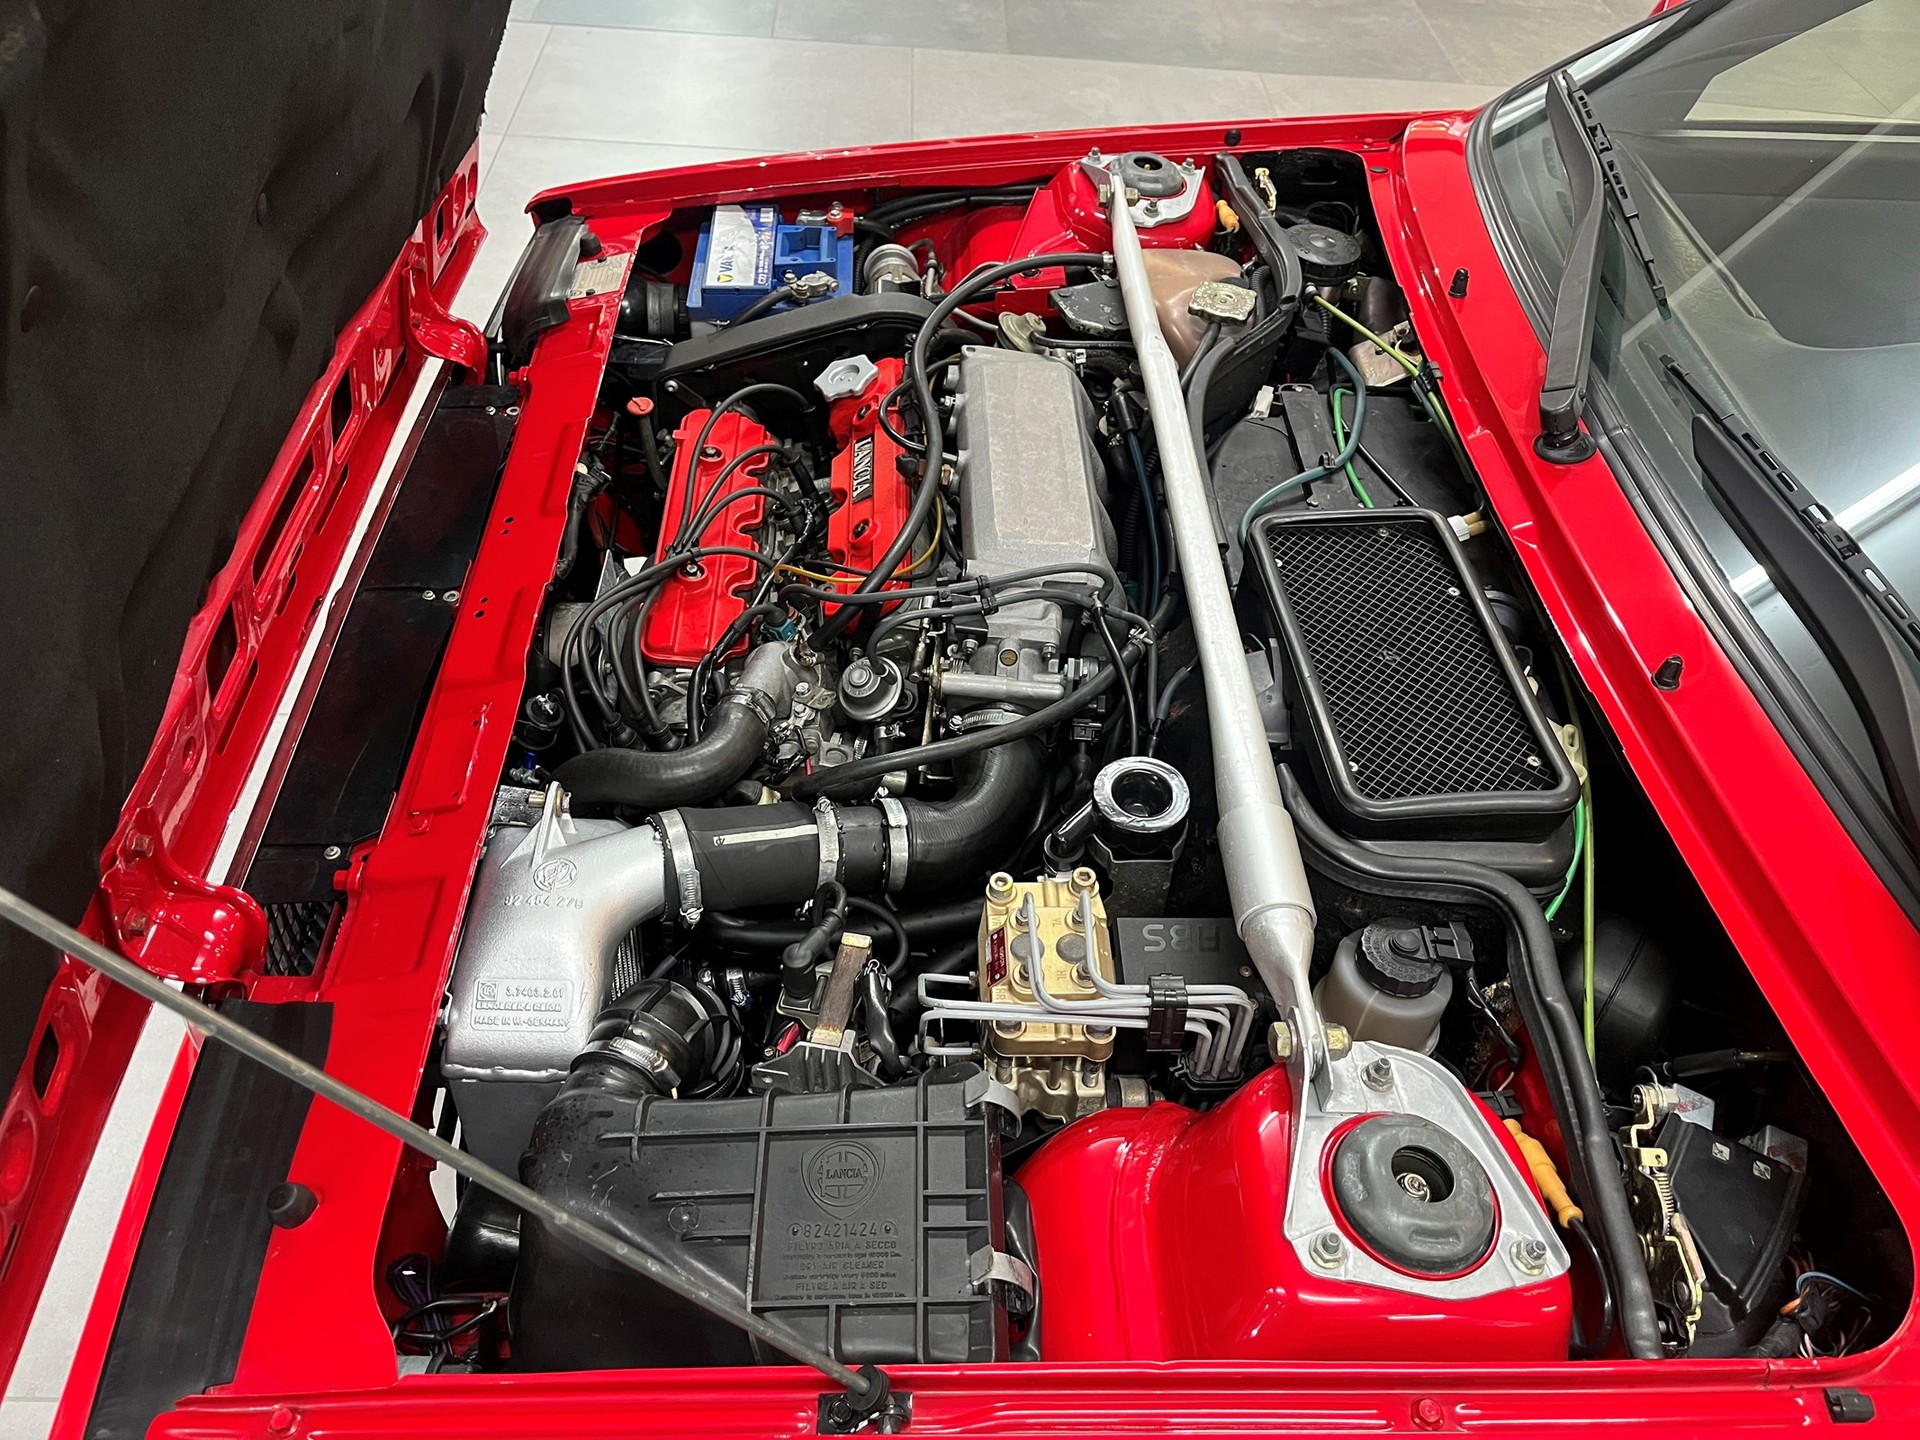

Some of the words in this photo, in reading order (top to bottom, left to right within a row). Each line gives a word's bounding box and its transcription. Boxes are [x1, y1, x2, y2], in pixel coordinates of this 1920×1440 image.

[853, 437, 872, 498] LANCIA
[1142, 923, 1220, 952] ABS
[474, 1016, 499, 1025] MADE
[501, 1016, 511, 1026] IN
[825, 1168, 864, 1180] LANCIA
[803, 1222, 878, 1238] 82421424
[864, 1240, 897, 1250] SECCO
[869, 1280, 888, 1290] SEC
